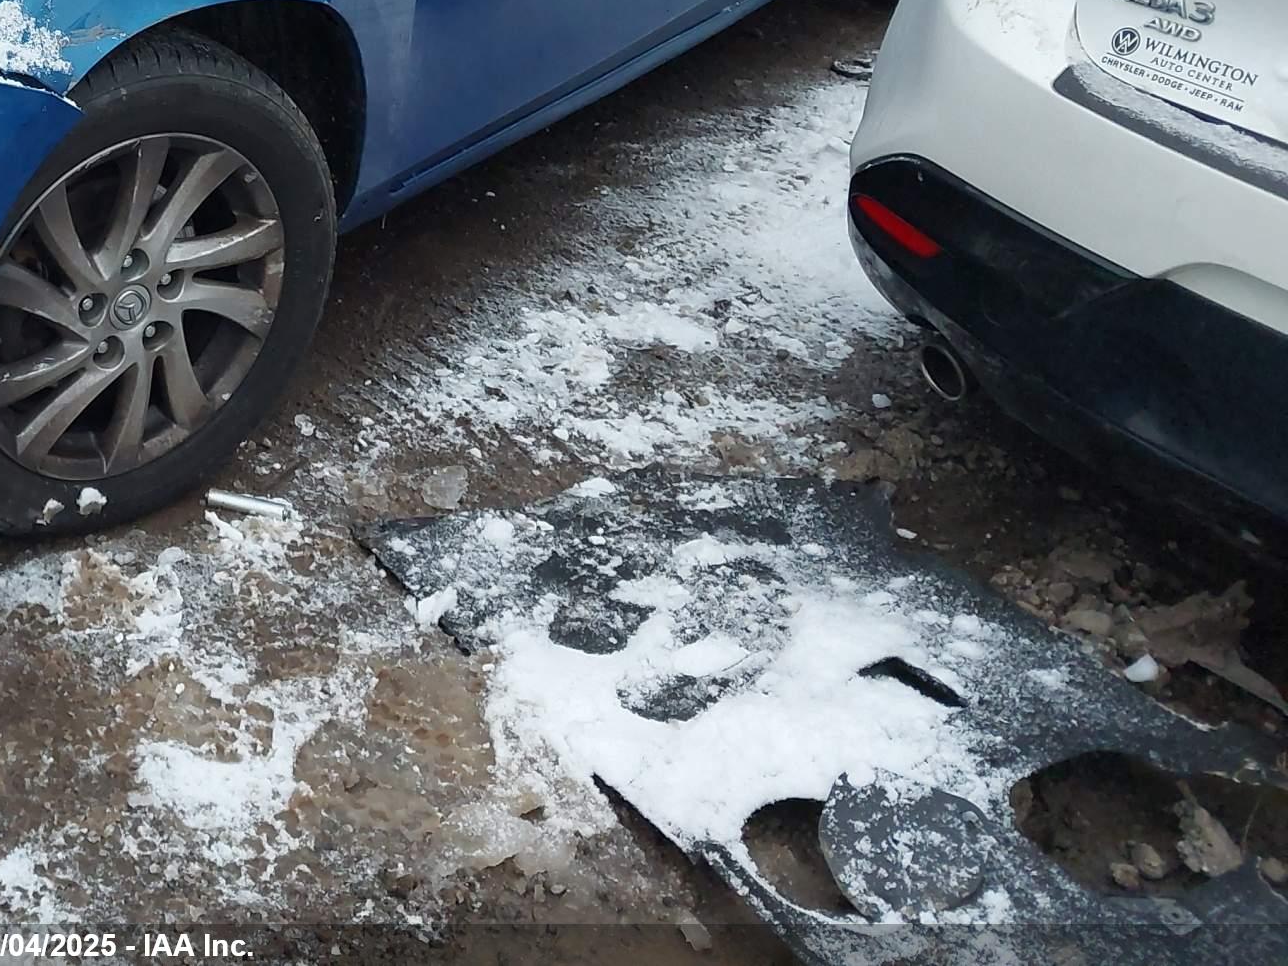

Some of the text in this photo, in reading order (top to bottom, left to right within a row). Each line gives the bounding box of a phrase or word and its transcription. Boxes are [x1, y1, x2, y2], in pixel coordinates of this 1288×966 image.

[1143, 17, 1202, 42] AWD
[1146, 37, 1259, 86] WILMINGTON
[1150, 56, 1233, 92] AUTO CENTER
[1101, 56, 1244, 112] CHRYSLER DODGE JEEP RAM
